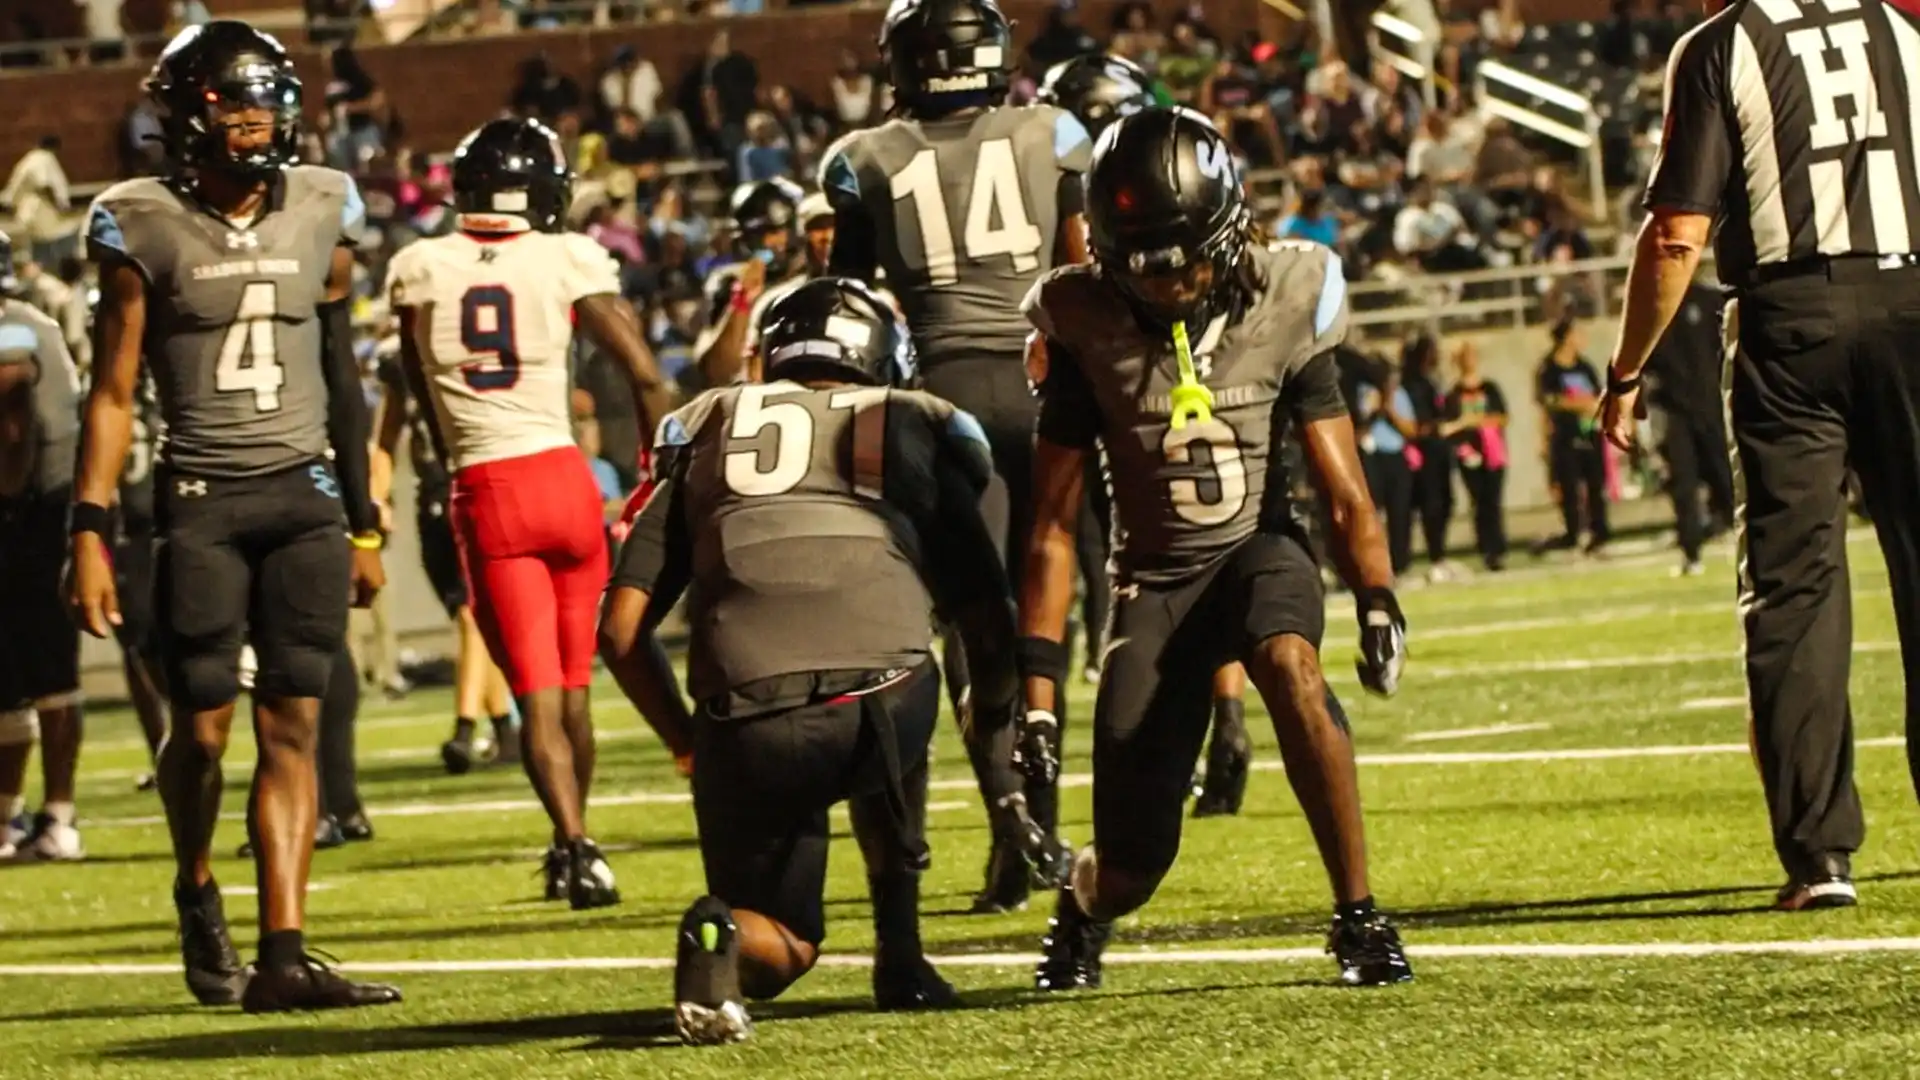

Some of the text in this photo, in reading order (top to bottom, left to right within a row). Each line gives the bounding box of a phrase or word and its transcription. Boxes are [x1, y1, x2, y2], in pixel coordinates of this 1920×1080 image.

[1785, 18, 1888, 150] H
[890, 137, 1042, 286] 14
[215, 282, 284, 412] 4
[460, 283, 521, 392] 9
[724, 384, 890, 500] 51
